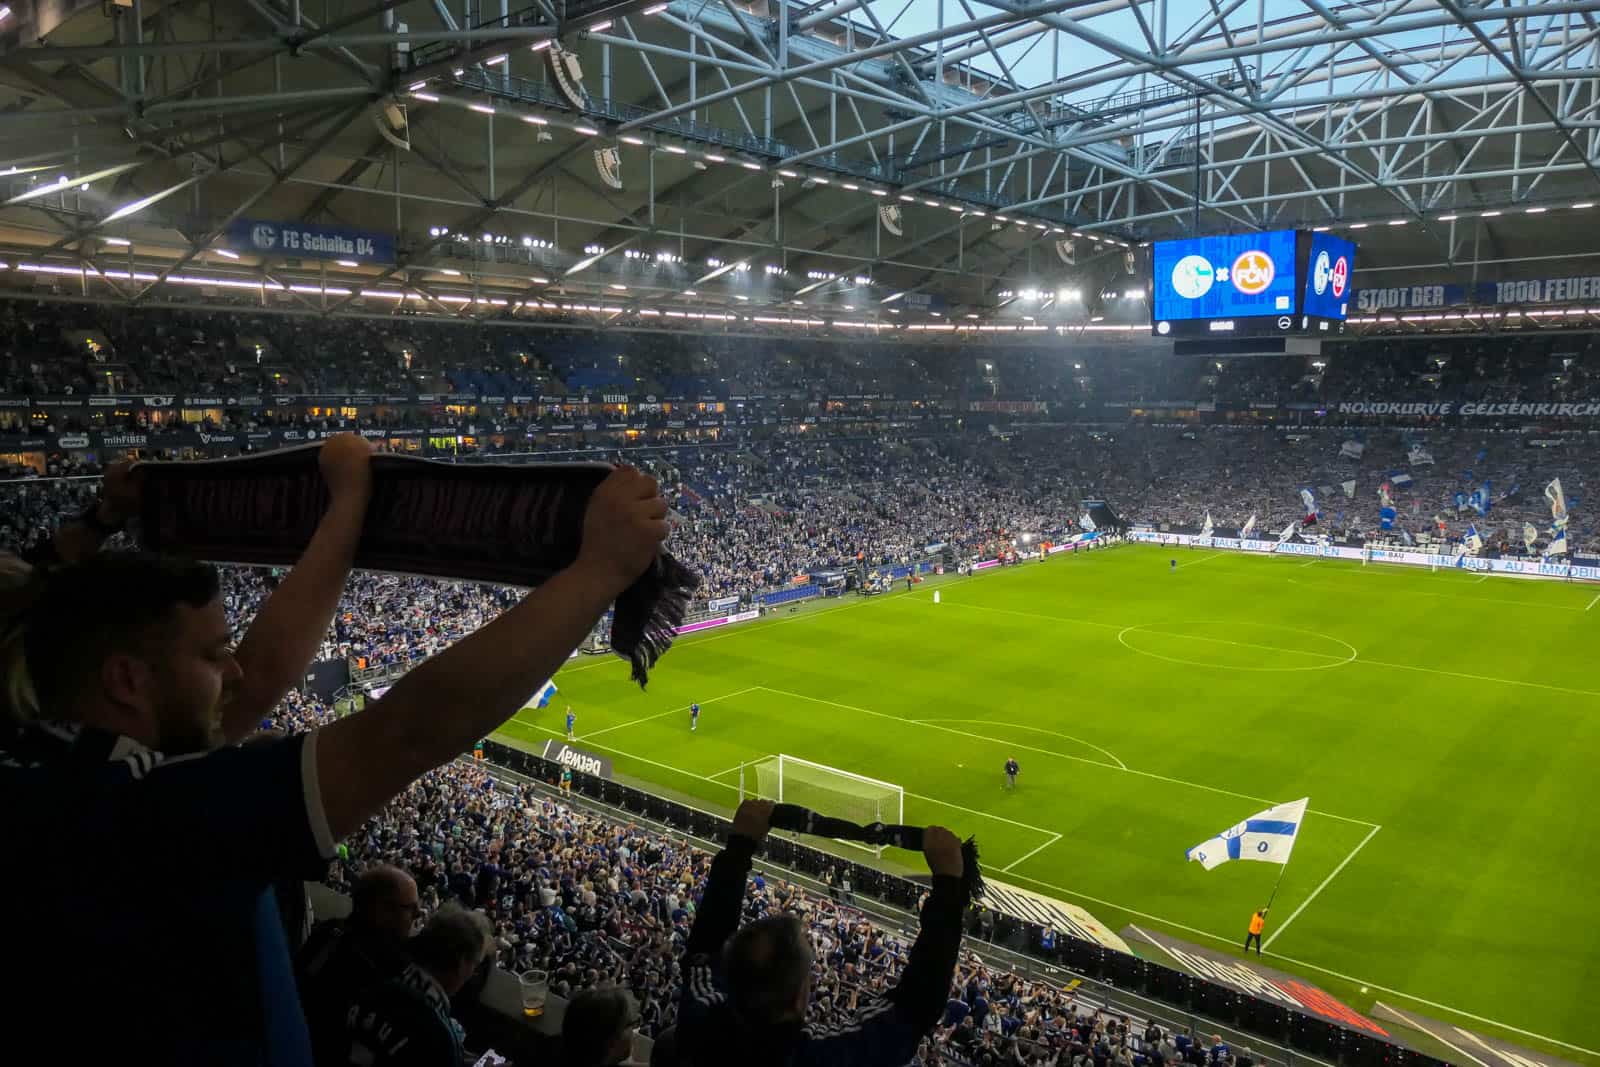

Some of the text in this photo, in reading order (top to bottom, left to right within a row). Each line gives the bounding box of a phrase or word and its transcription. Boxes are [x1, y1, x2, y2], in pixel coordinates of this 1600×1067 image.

[282, 230, 375, 256] FC Schalke 04
[1357, 286, 1445, 310] STADT DER
[1496, 276, 1600, 303] 1000 FEUER
[1338, 402, 1451, 416] NORDKURVE
[555, 744, 602, 777] betway
